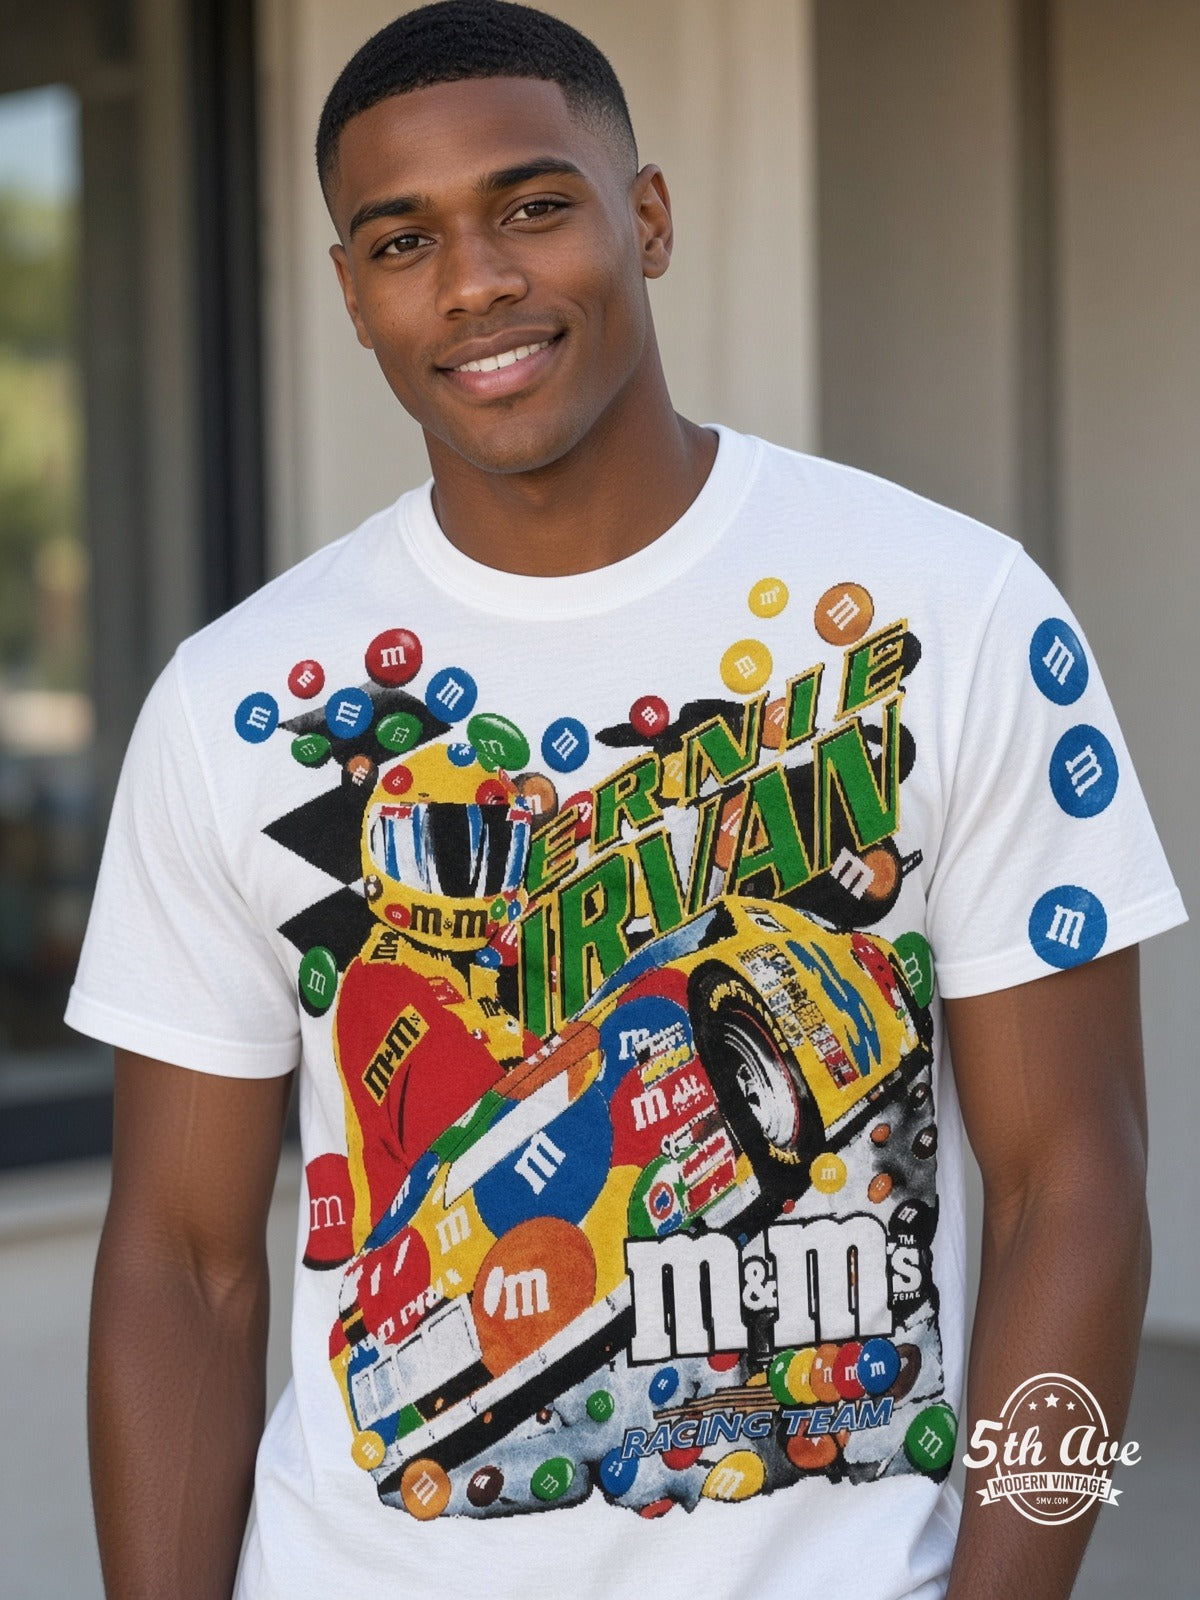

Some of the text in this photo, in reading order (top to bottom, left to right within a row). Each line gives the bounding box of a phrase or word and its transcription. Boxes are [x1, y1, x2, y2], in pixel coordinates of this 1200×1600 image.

[826, 593, 860, 631] m
[381, 645, 407, 668] m
[1042, 635, 1075, 686] m
[437, 677, 464, 711] m
[247, 705, 271, 731] m
[336, 701, 362, 727] m
[526, 618, 908, 896] ERNIE
[552, 727, 579, 761] m
[1065, 745, 1102, 797] m
[519, 690, 905, 1039] IRVAN
[830, 846, 874, 899] m
[1046, 904, 1086, 950] m
[307, 969, 327, 997] m
[631, 1087, 670, 1131] m
[515, 1131, 566, 1195] m
[311, 1194, 346, 1231] m
[436, 1204, 471, 1255] m
[504, 1268, 550, 1320] m
[870, 1361, 886, 1377] m
[621, 1396, 894, 1459] RACING TEAM
[919, 1426, 943, 1459] m
[412, 1471, 439, 1506] m
[540, 1476, 560, 1494] m
